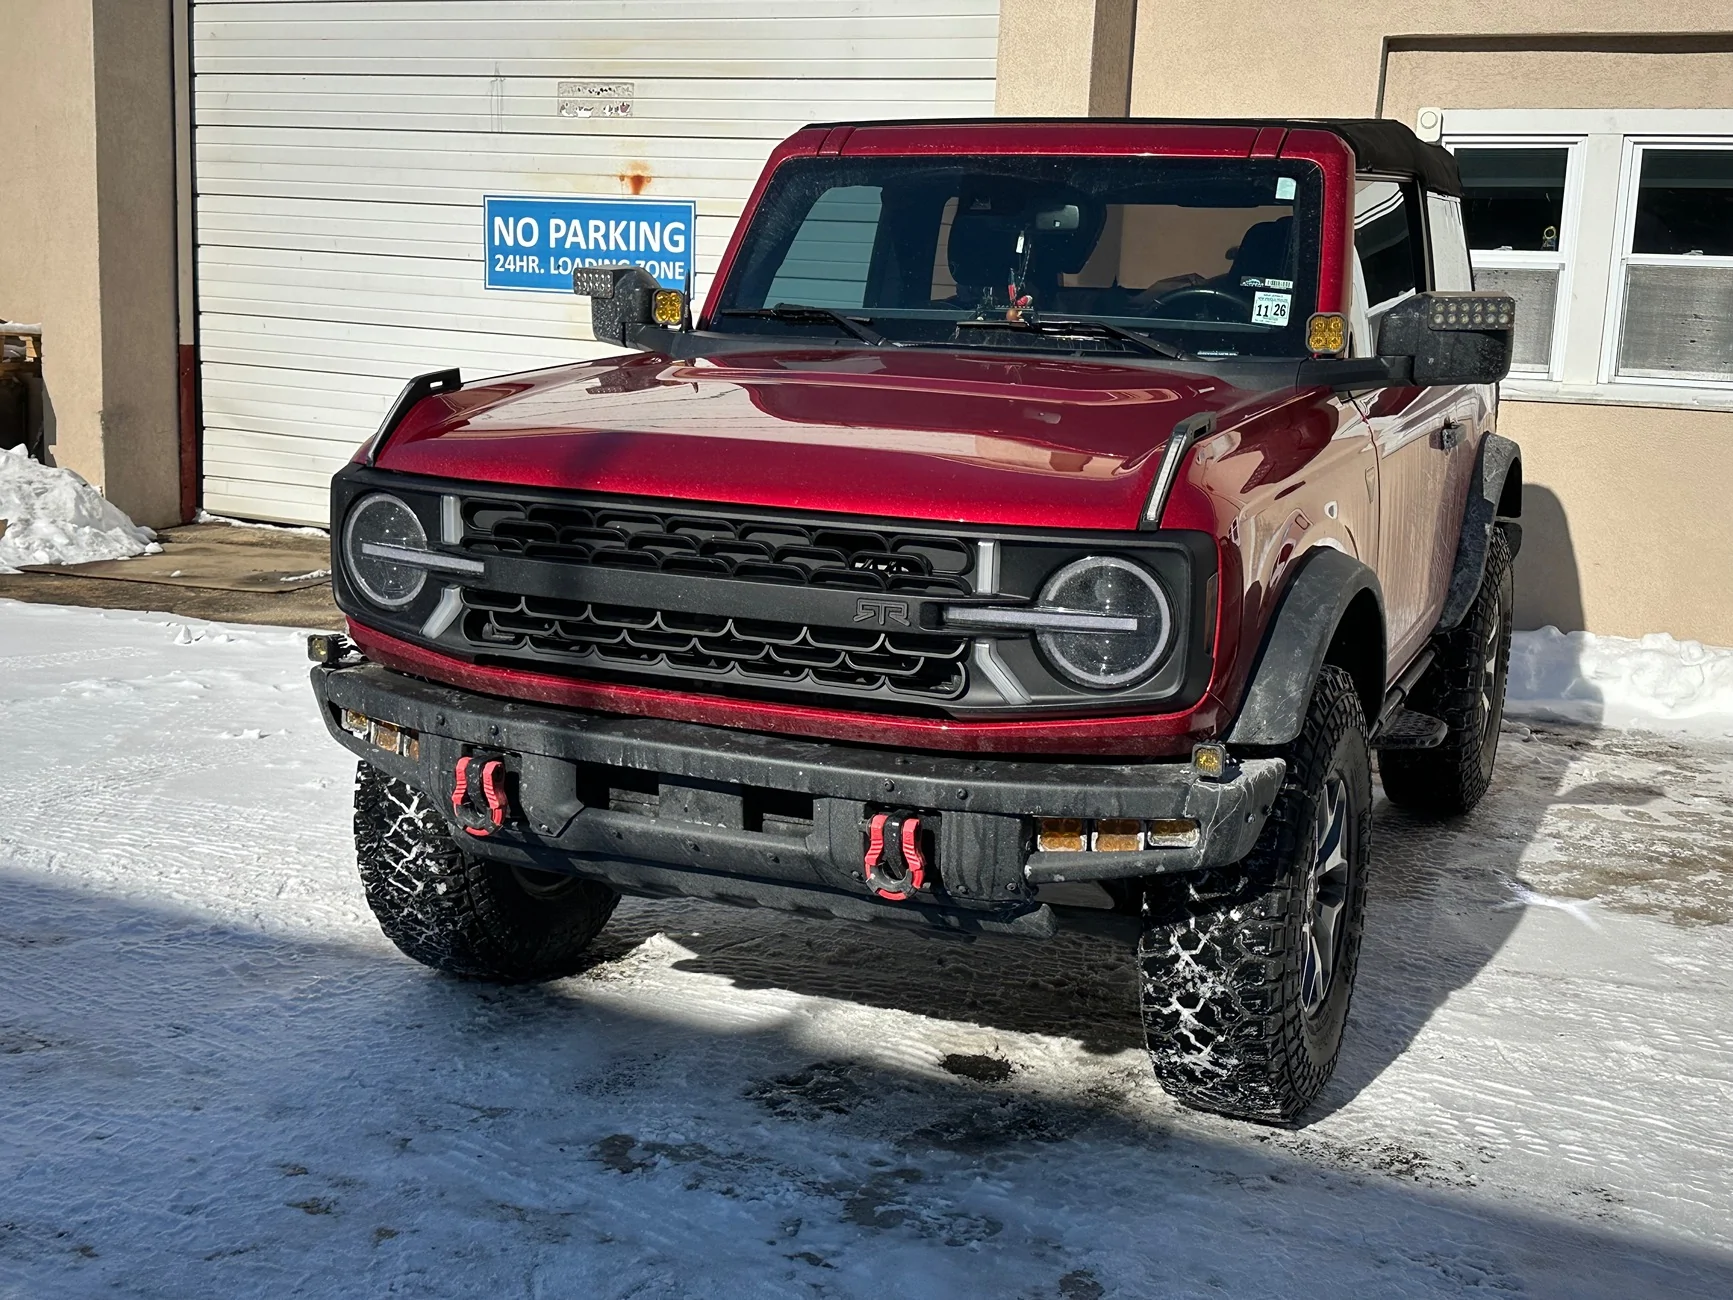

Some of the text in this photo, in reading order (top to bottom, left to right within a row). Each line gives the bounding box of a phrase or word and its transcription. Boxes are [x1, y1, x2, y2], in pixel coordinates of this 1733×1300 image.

[494, 216, 686, 253] NO PARKING
[495, 254, 544, 274] 24HR.
[1256, 303, 1287, 318] 11 26
